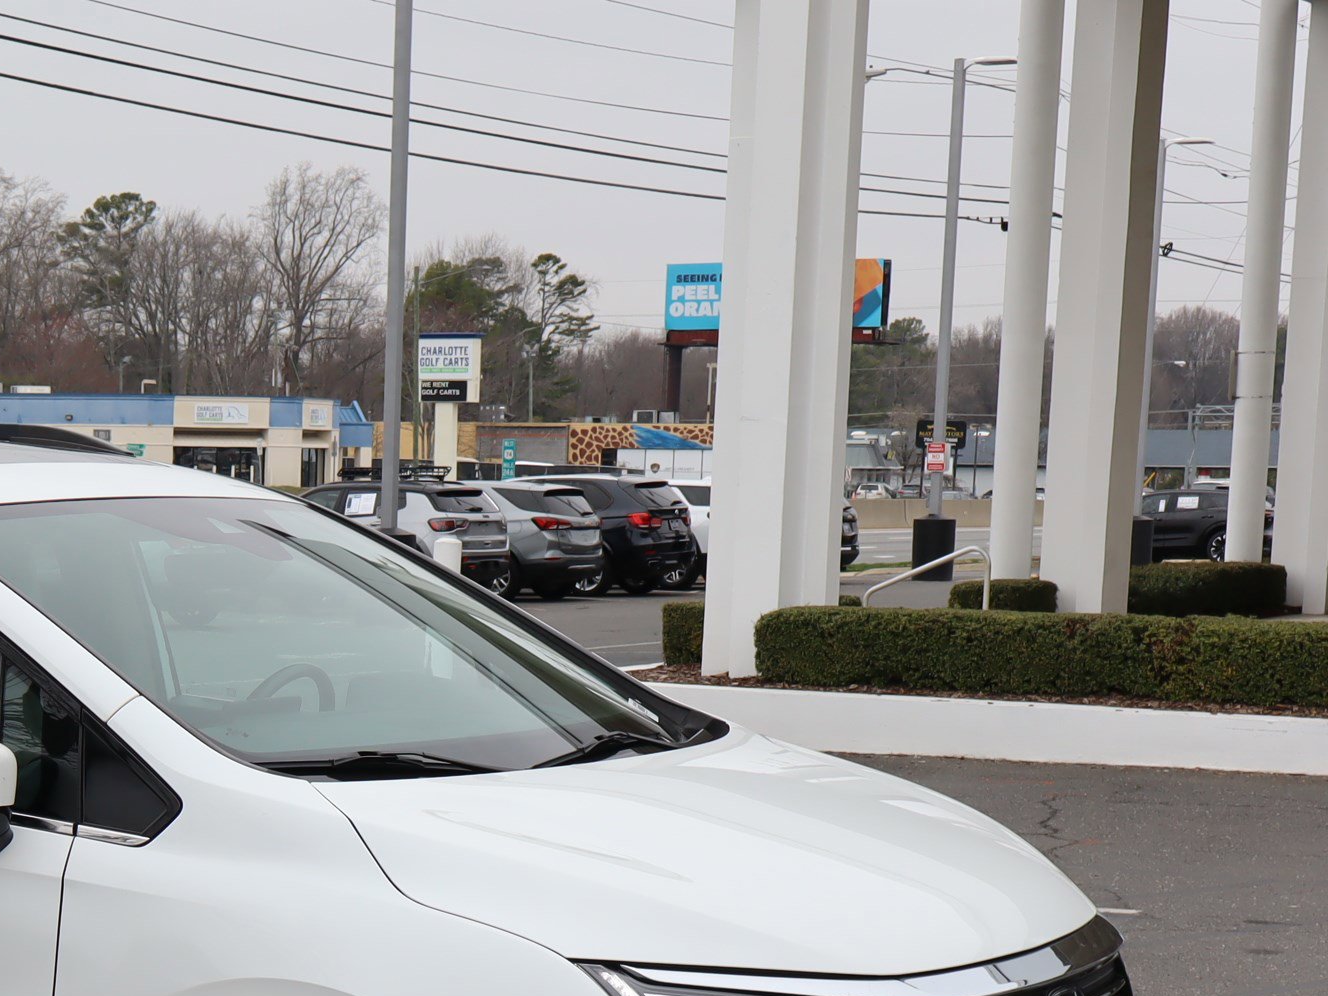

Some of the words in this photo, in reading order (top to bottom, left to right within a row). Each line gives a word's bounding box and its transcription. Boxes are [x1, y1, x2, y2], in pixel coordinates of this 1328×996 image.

[676, 274, 717, 283] SEEING
[672, 284, 719, 300] PEEL
[421, 346, 469, 356] CHARLOTTE
[419, 357, 440, 367] GOLF
[443, 357, 470, 367] CARTS
